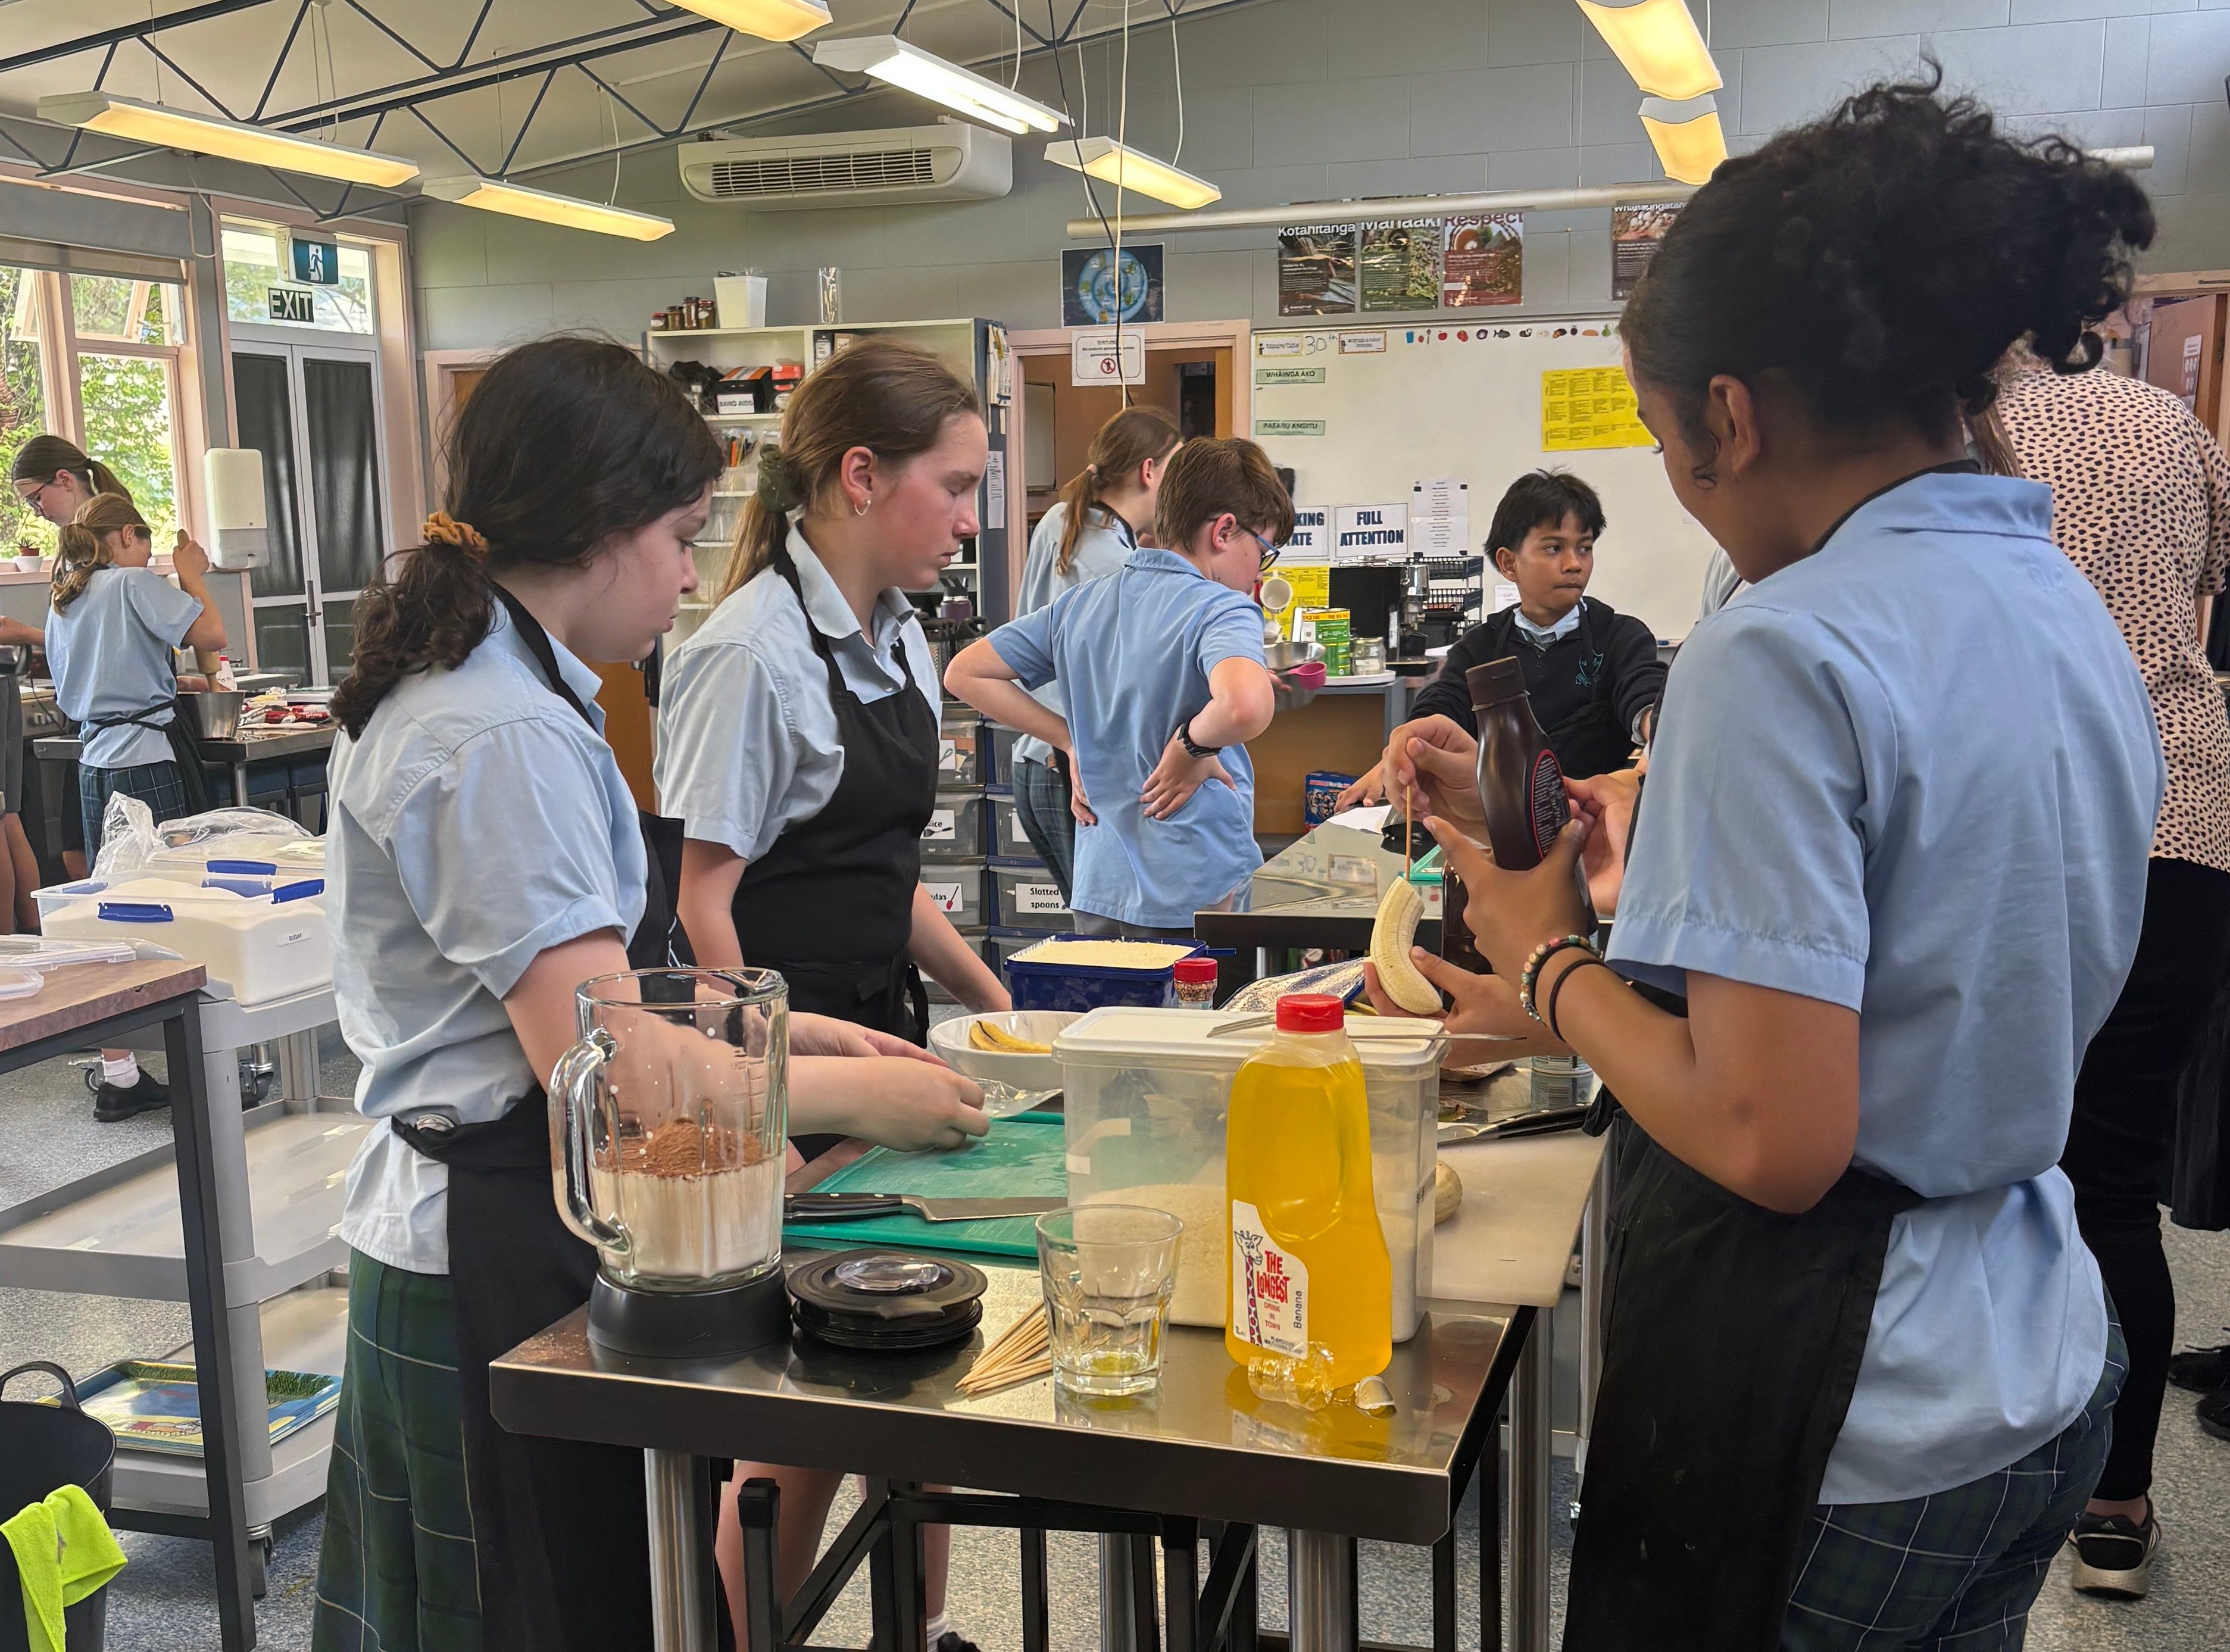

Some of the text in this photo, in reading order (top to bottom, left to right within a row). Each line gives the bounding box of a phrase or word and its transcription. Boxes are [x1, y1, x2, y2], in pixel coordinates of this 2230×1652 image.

[1445, 213, 1523, 227] Respect
[269, 289, 311, 320] EXIT
[1294, 512, 1325, 526] KING
[1357, 511, 1383, 526] FULL
[1287, 532, 1313, 546] ATE
[1340, 529, 1404, 546] ATTENTION
[1030, 887, 1059, 895] Slotted
[1264, 1250, 1283, 1275] THE
[1256, 1270, 1290, 1304] LONGEST
[1264, 1301, 1280, 1313] DRINK
[1293, 1291, 1302, 1329] Banana
[1265, 1320, 1280, 1331] TOWN
